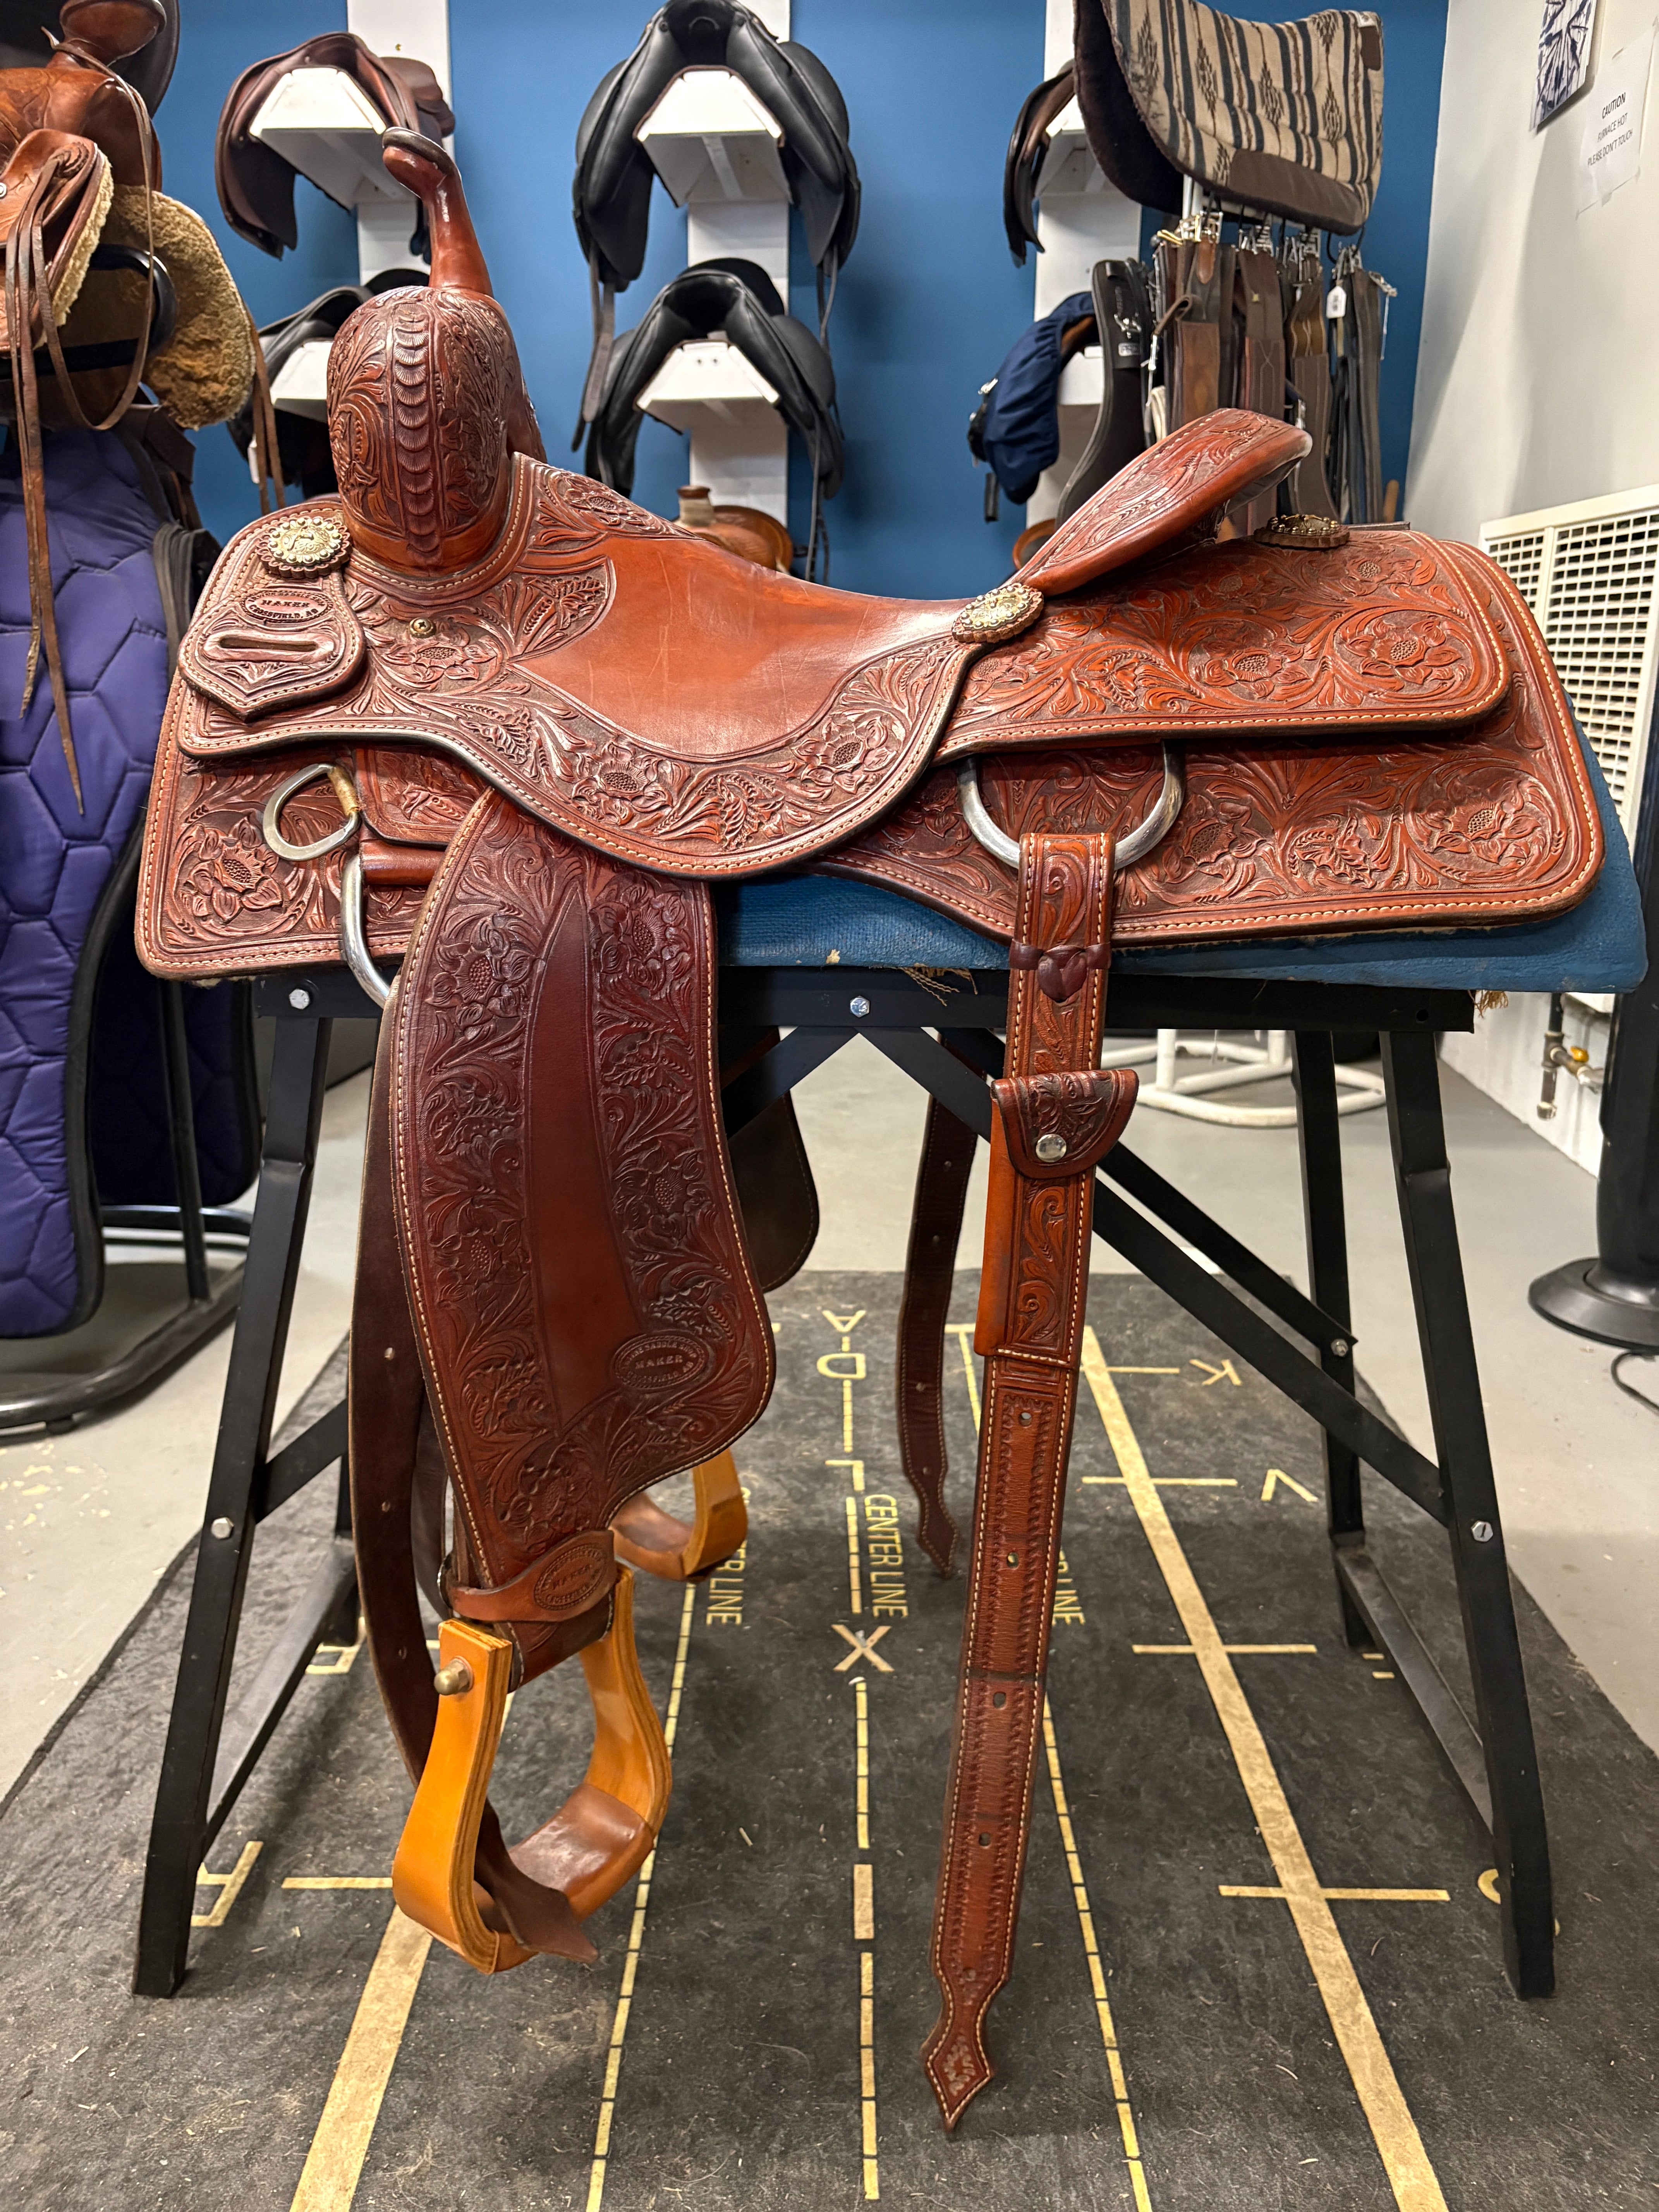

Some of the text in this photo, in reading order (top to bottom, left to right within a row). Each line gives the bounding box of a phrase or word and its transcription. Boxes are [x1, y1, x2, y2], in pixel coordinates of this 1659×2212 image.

[1602, 92, 1626, 119] CAUTION
[1597, 112, 1628, 143] FURNACE HOT
[1588, 128, 1633, 168] PLEASE DON'T TOUCH
[261, 599, 310, 608] MAKER
[821, 1310, 866, 1333] A
[635, 1355, 683, 1369] MAKER
[816, 1353, 866, 1380] D
[1189, 1359, 1241, 1386] K
[824, 1459, 865, 1491] L
[1260, 1468, 1318, 1502] V
[864, 1494, 909, 1619] CENTER LINE
[706, 1578, 744, 1625] LINE
[831, 1625, 894, 1672] X
